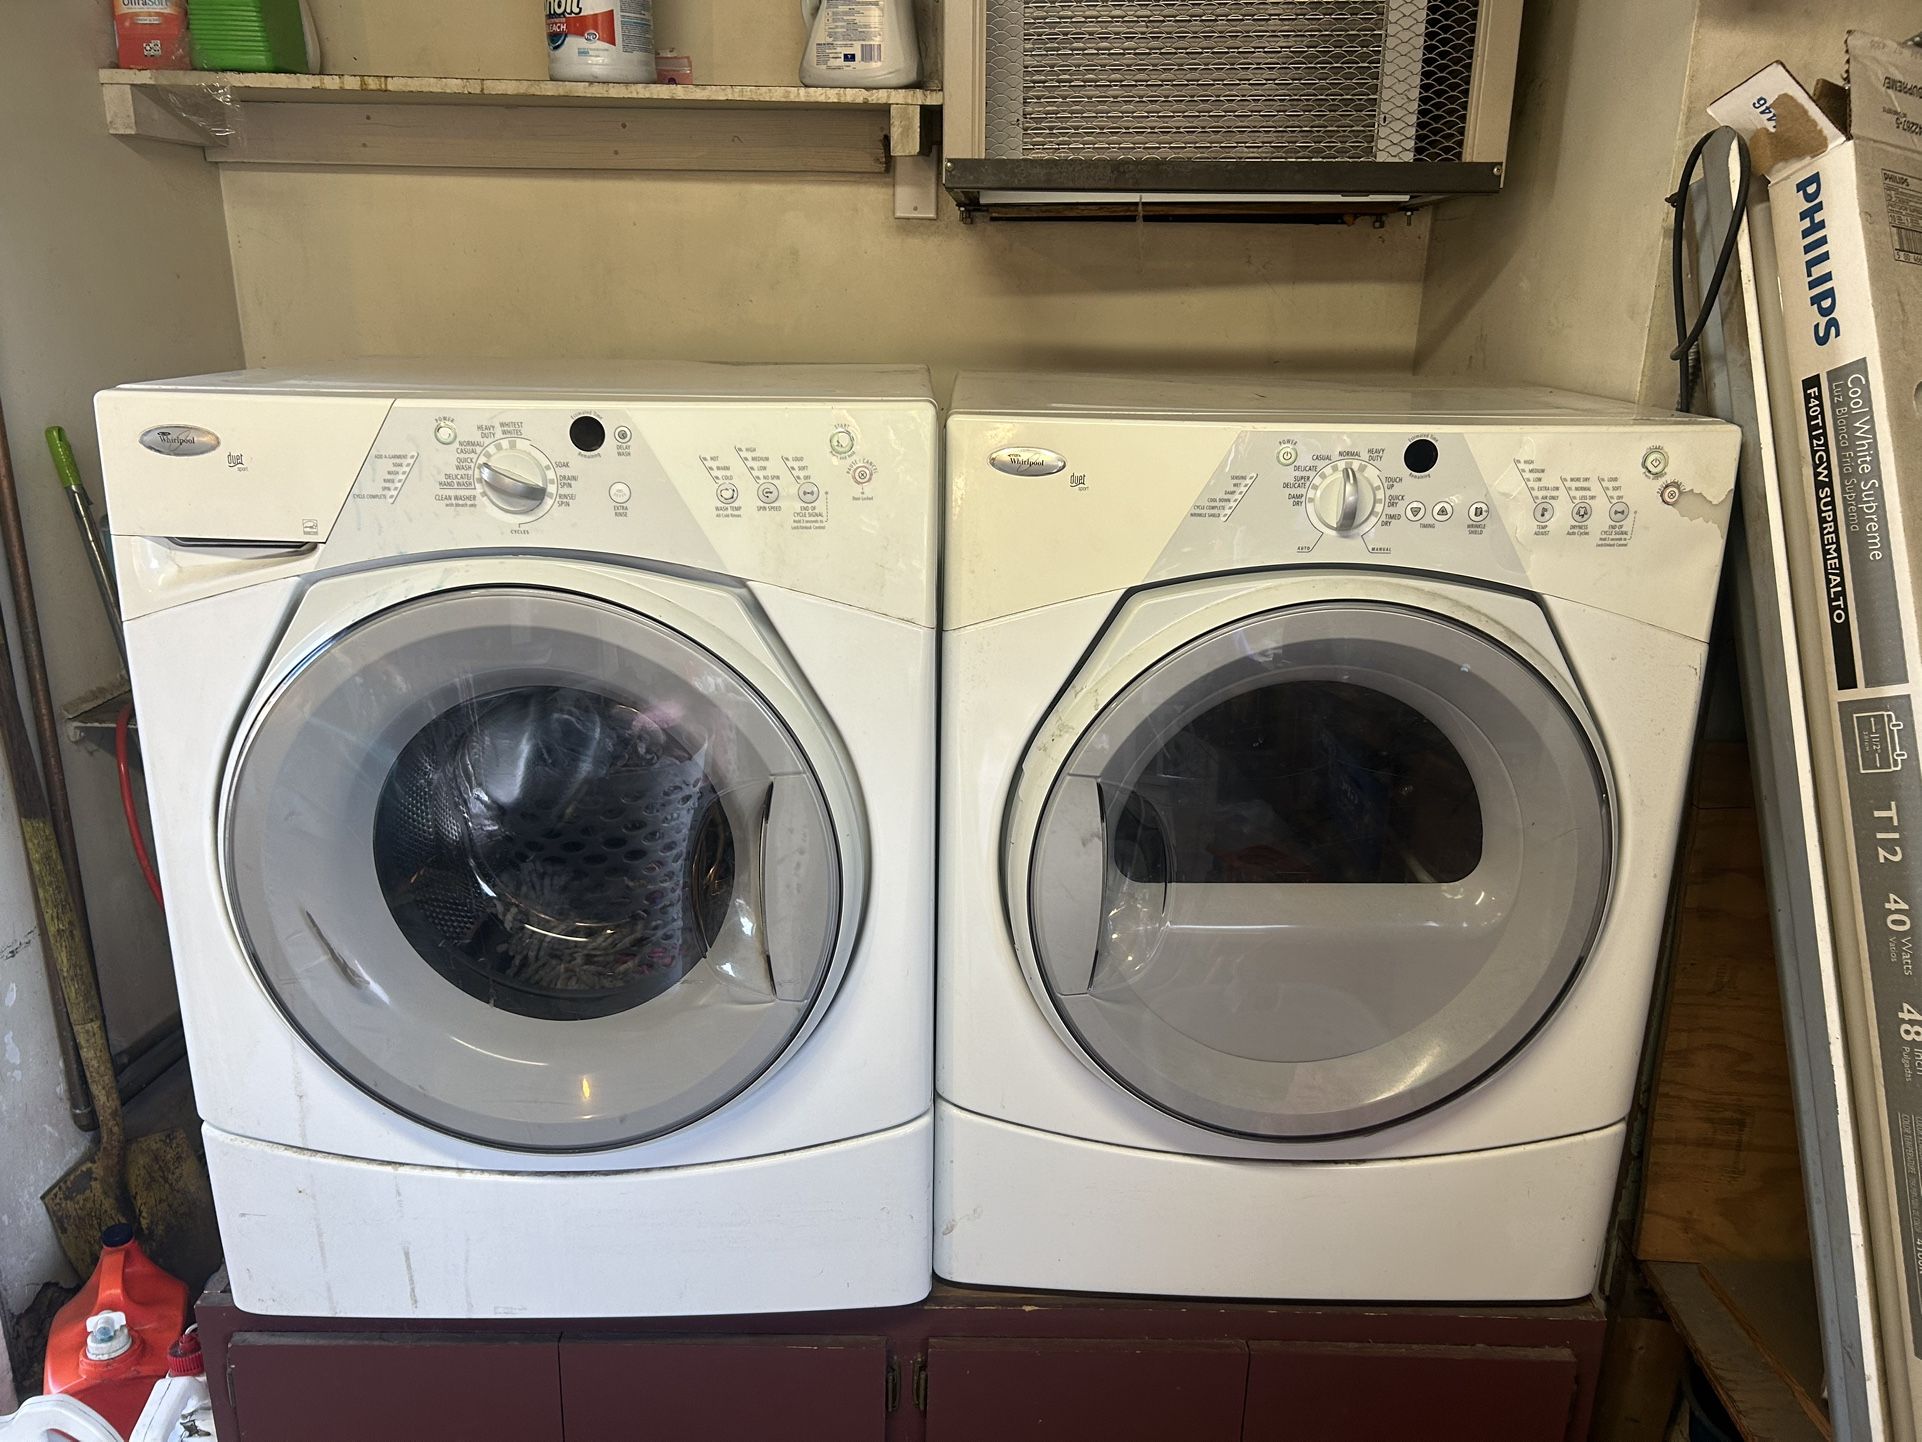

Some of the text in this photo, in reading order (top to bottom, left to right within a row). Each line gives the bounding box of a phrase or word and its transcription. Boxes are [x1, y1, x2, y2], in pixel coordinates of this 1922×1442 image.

[1883, 172, 1910, 188] PHILIPS
[1796, 171, 1841, 347] PHILIPS
[434, 415, 455, 423] POWER
[476, 424, 496, 432] HEAVY
[499, 421, 524, 429] WHITEST
[501, 428, 523, 436] WHITES
[160, 435, 195, 446] Whirlpool
[458, 440, 485, 448] NORMAL/
[1278, 438, 1298, 446] POWER
[456, 447, 478, 455] CASUAL
[1338, 450, 1361, 458] NORMAL
[227, 451, 244, 465] duet
[456, 456, 474, 464] QUICK
[1832, 381, 1860, 532] Luz Blanca Fría Suprema
[1010, 457, 1044, 467] Whirlpool
[1847, 374, 1883, 561] Cool White Supreme
[1069, 472, 1086, 485] duet
[1384, 476, 1403, 484] TOUCH
[434, 494, 477, 502] CLEAN WASHER
[558, 493, 577, 501] RINSE/
[1387, 494, 1405, 502] QUICK
[557, 500, 571, 508] SPIN
[1384, 513, 1402, 521] TIMED
[1819, 487, 1846, 624] SUPREME/ALTO
[1873, 801, 1903, 864] T12
[1884, 892, 1912, 932] 40
[1899, 936, 1913, 976] Watts
[1898, 1002, 1922, 1042] 48
